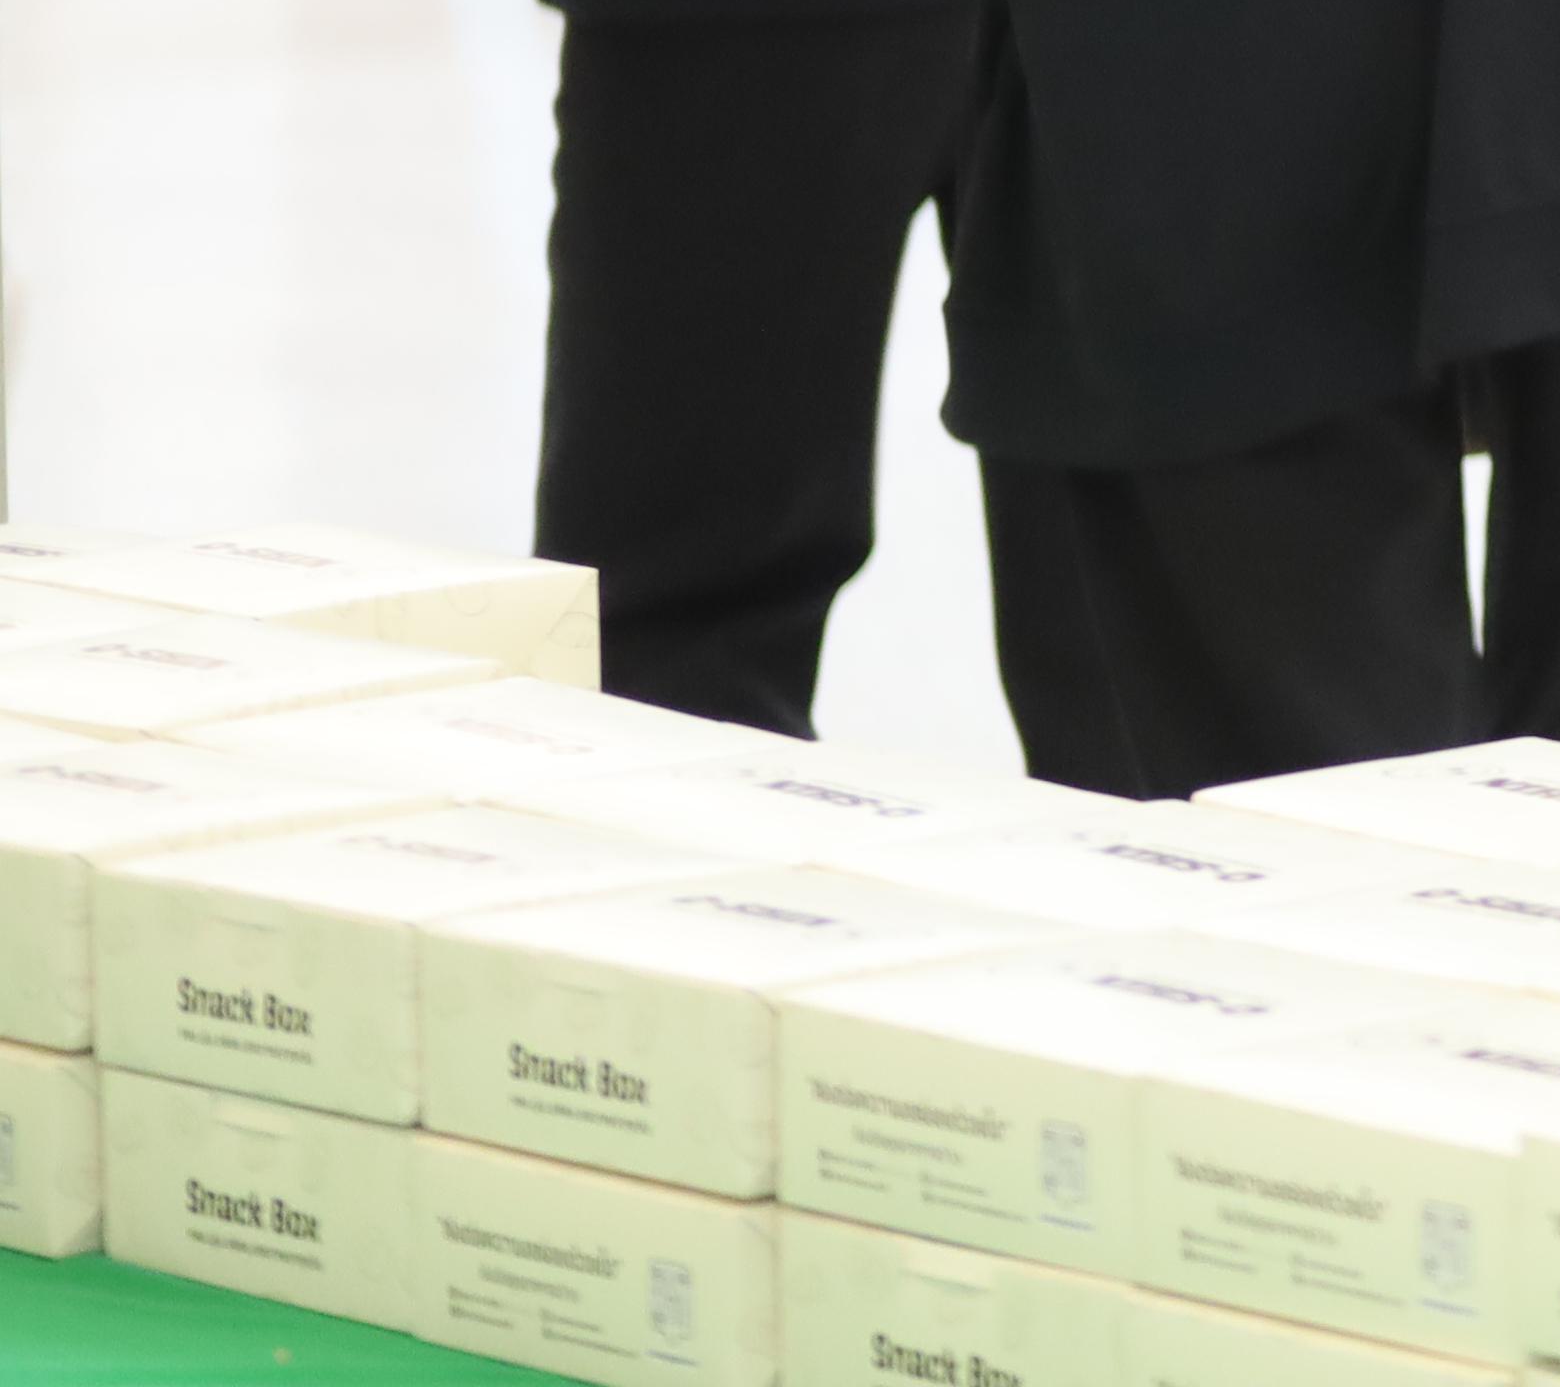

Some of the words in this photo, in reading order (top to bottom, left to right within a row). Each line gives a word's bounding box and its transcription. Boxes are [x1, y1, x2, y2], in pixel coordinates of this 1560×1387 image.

[178, 978, 254, 1025] Snack
[263, 993, 312, 1036] Box
[509, 1042, 589, 1093] Snack
[599, 1060, 649, 1107] Box
[186, 1178, 263, 1229] Snack
[271, 1198, 321, 1244] Box
[871, 1332, 956, 1386] Snack
